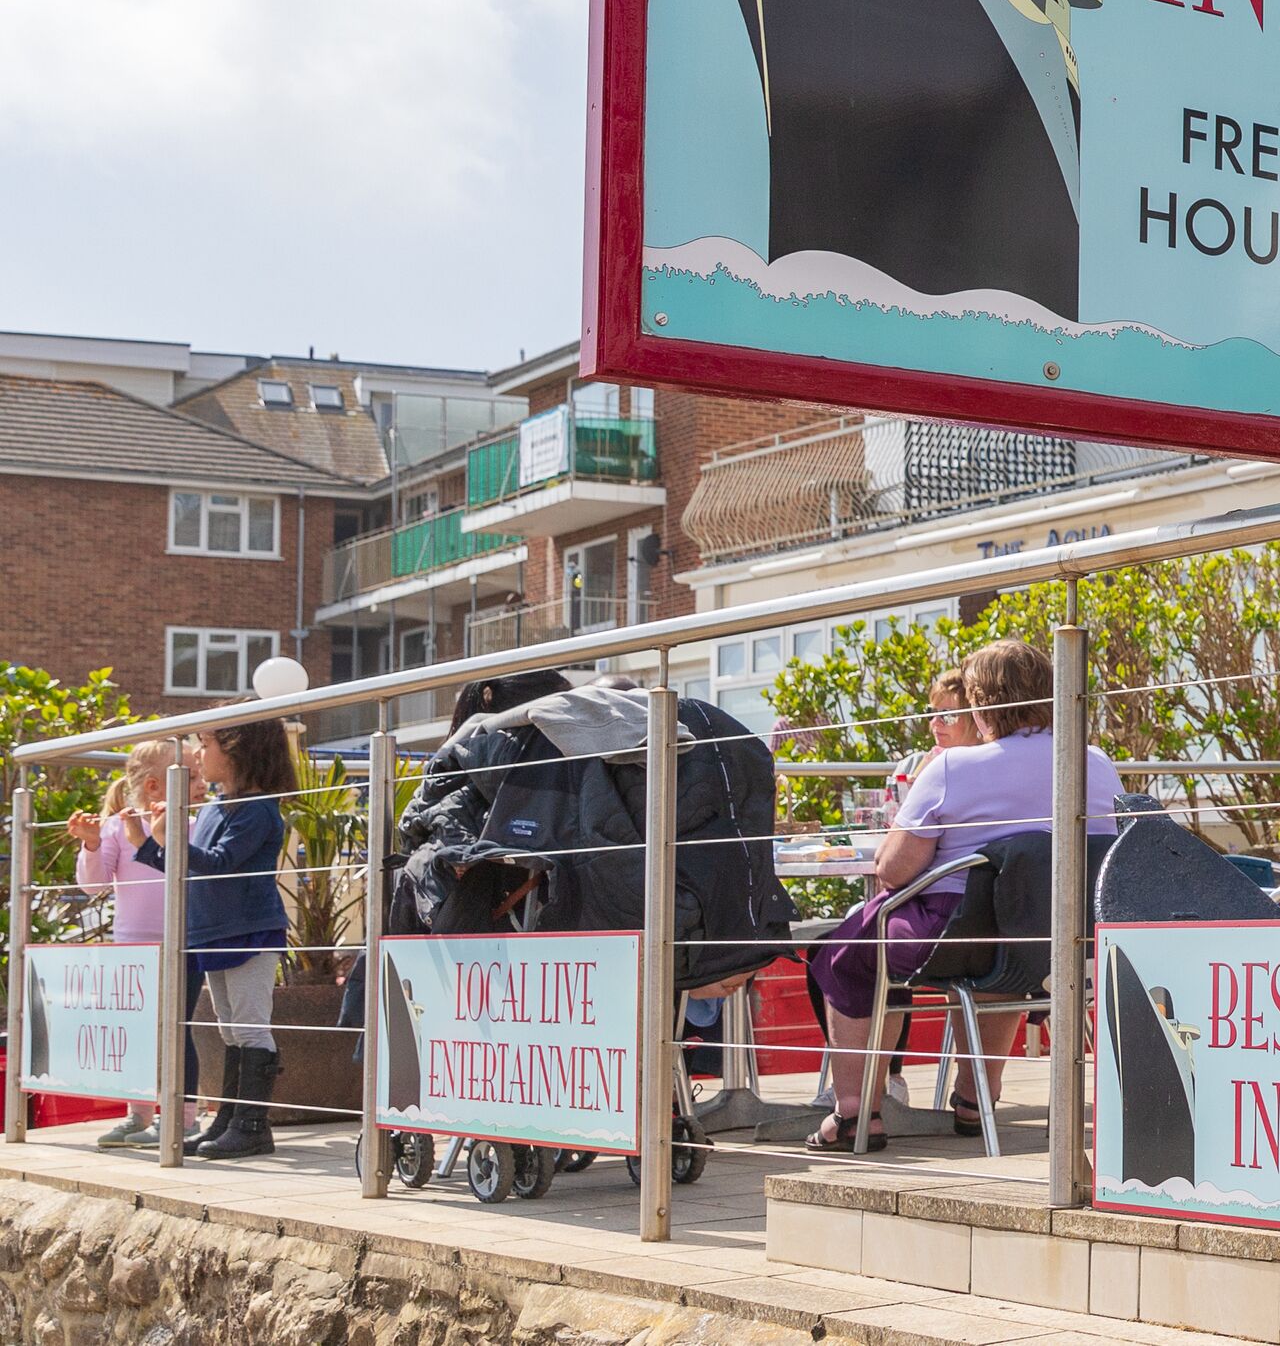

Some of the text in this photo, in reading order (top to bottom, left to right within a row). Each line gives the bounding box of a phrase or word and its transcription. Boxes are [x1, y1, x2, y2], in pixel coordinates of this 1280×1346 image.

[64, 964, 145, 1012] LOCAL ALES
[455, 961, 597, 1025] LOCAL LIVE
[77, 1024, 127, 1072] ON TAP
[428, 1039, 627, 1113] ENTERTAINMENT
